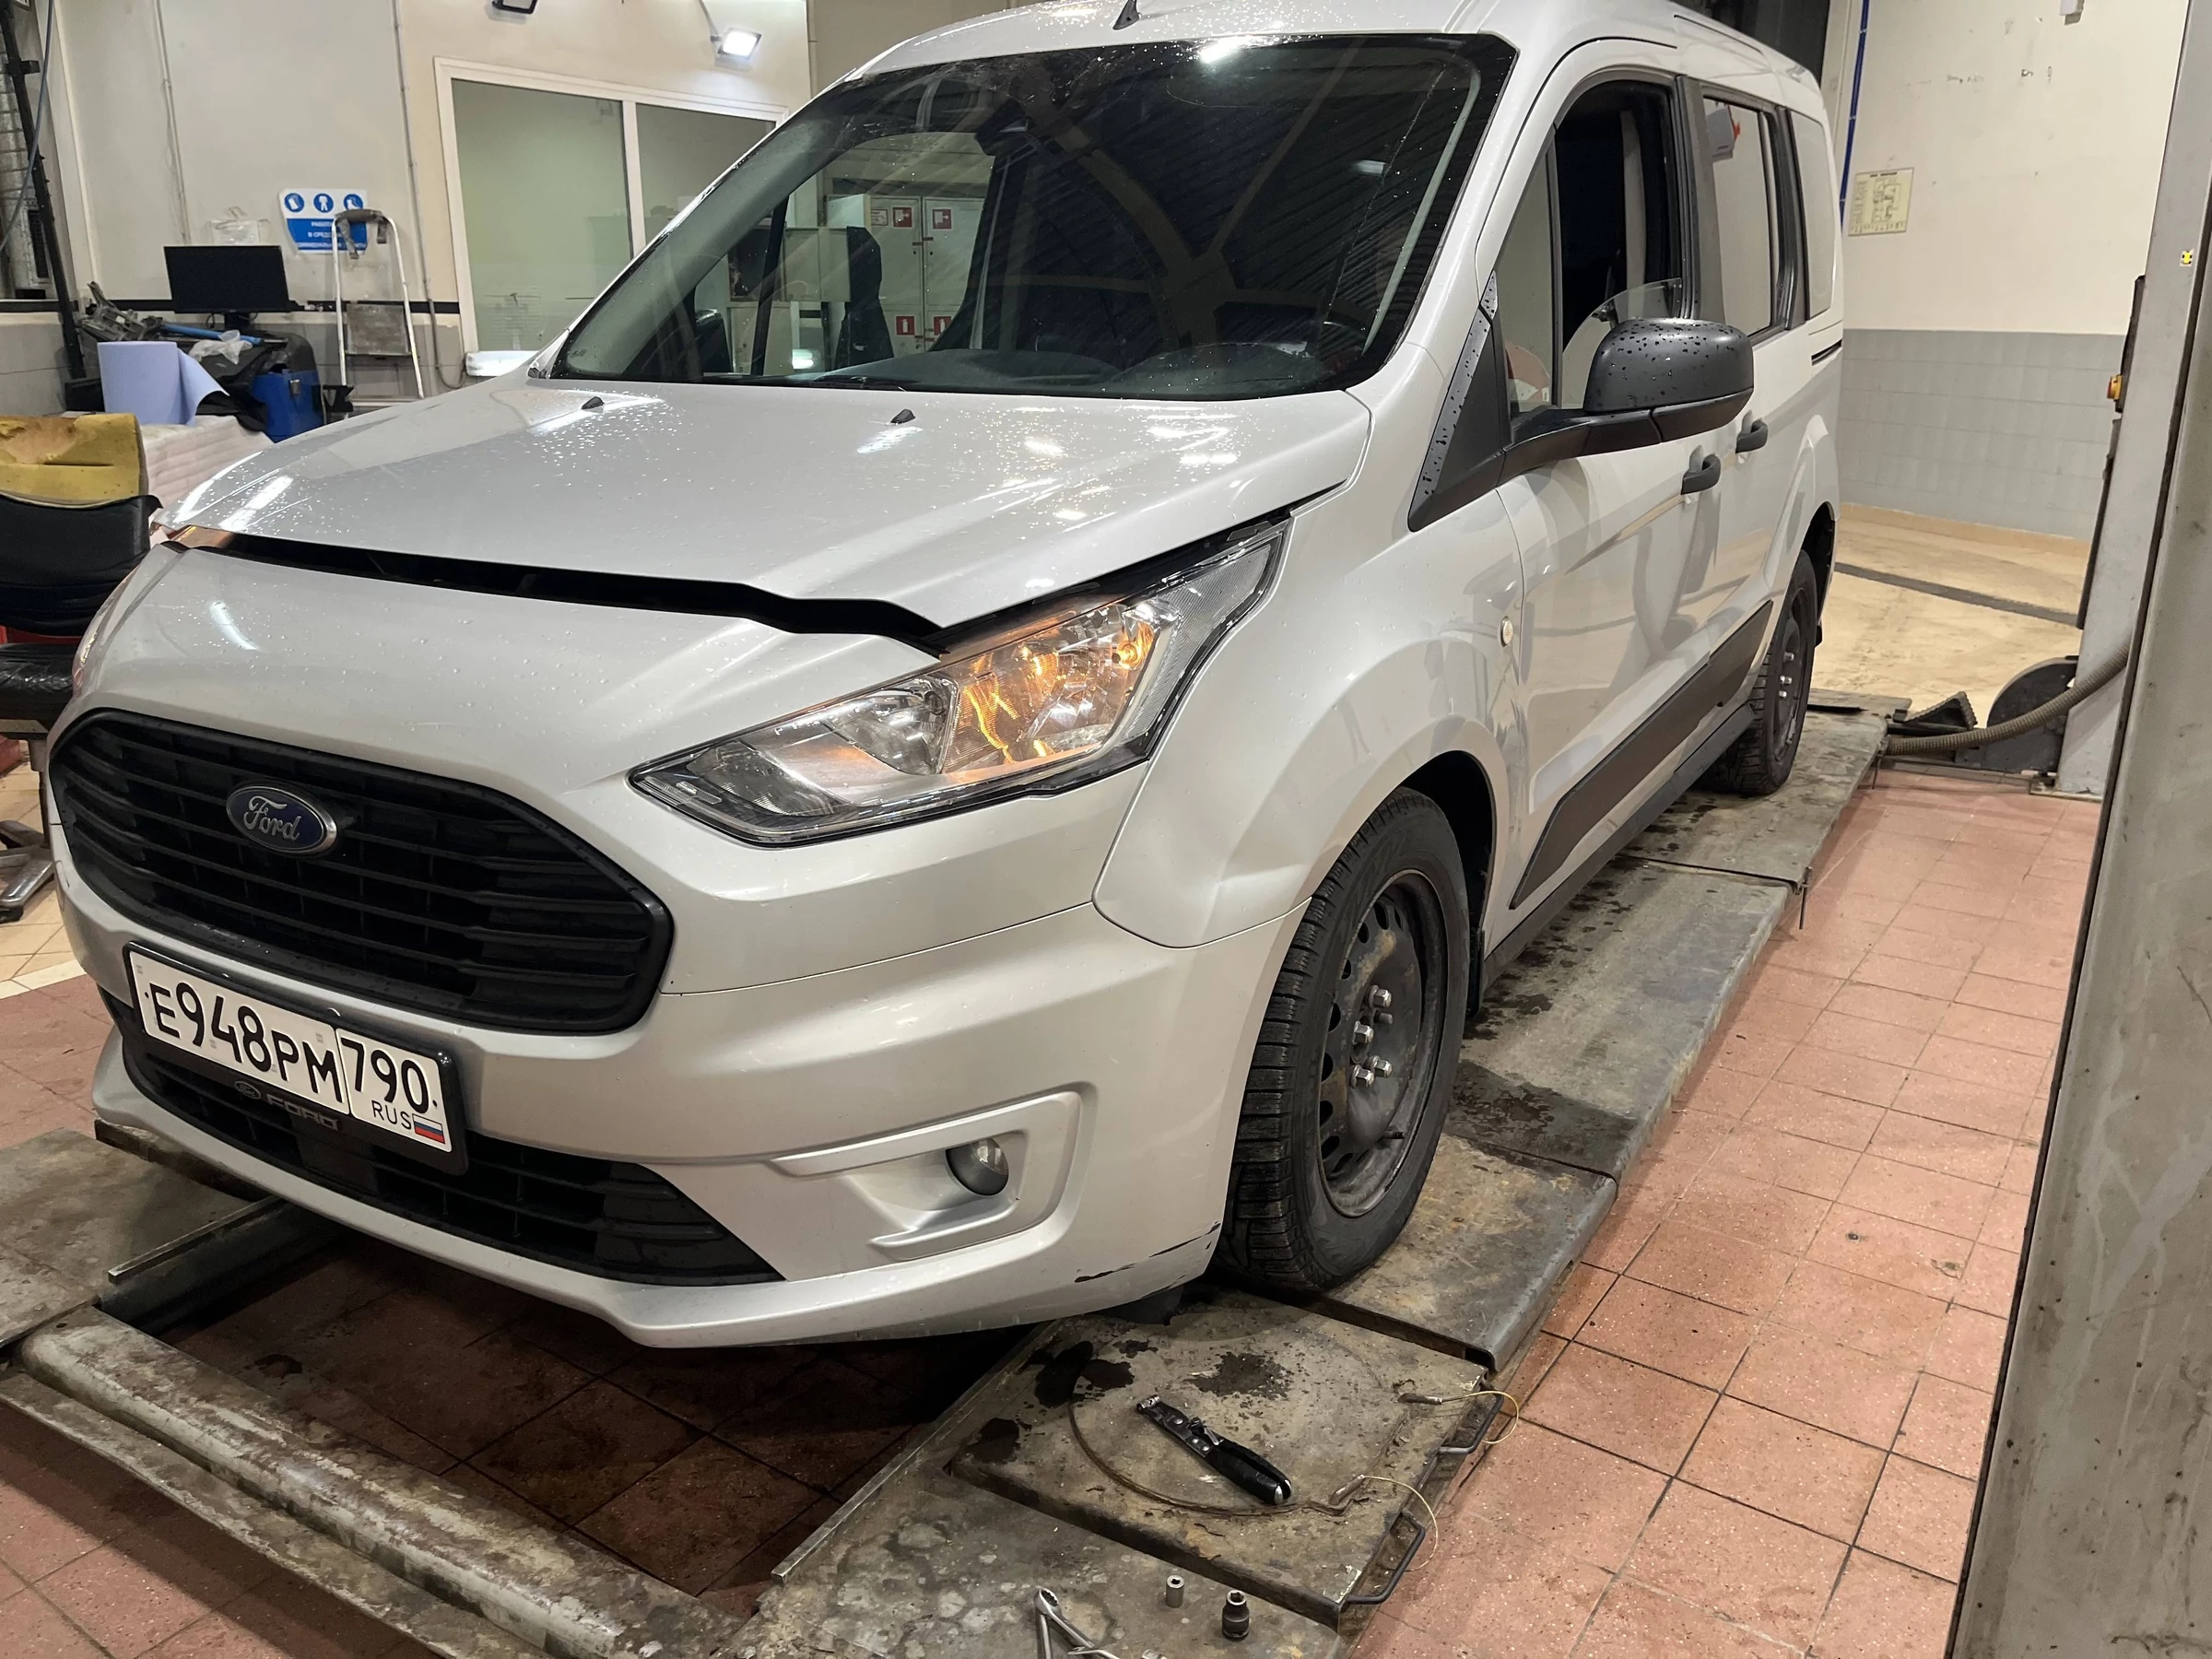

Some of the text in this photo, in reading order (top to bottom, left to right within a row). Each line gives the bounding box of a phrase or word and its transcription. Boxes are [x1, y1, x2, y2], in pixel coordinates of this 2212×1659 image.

[243, 795, 302, 841] Ford
[265, 1093, 339, 1132] FORD
[371, 1100, 413, 1131] RUS
